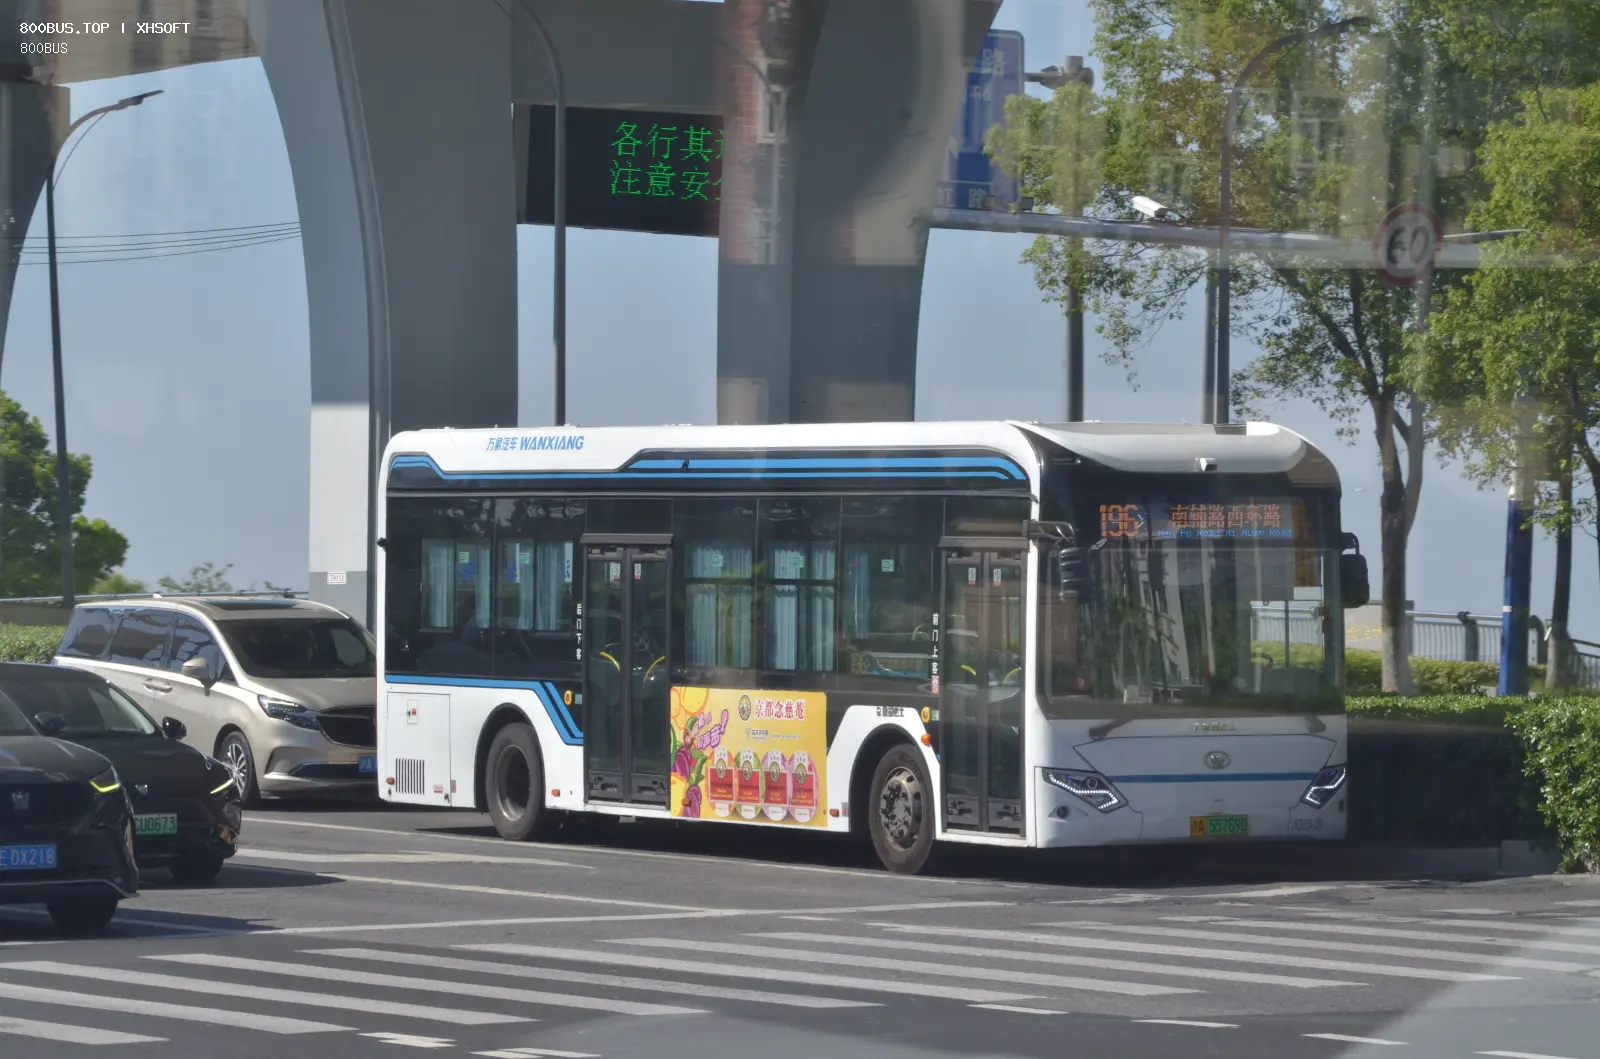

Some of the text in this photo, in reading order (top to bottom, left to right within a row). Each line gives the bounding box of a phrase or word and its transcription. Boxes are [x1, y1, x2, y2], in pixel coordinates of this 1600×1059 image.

[610, 121, 724, 162] 各行其
[609, 159, 723, 201] 注意安
[1386, 225, 1431, 264] 60
[486, 435, 585, 452] 万象汽车 WANXIANG
[1099, 503, 1140, 538] 196
